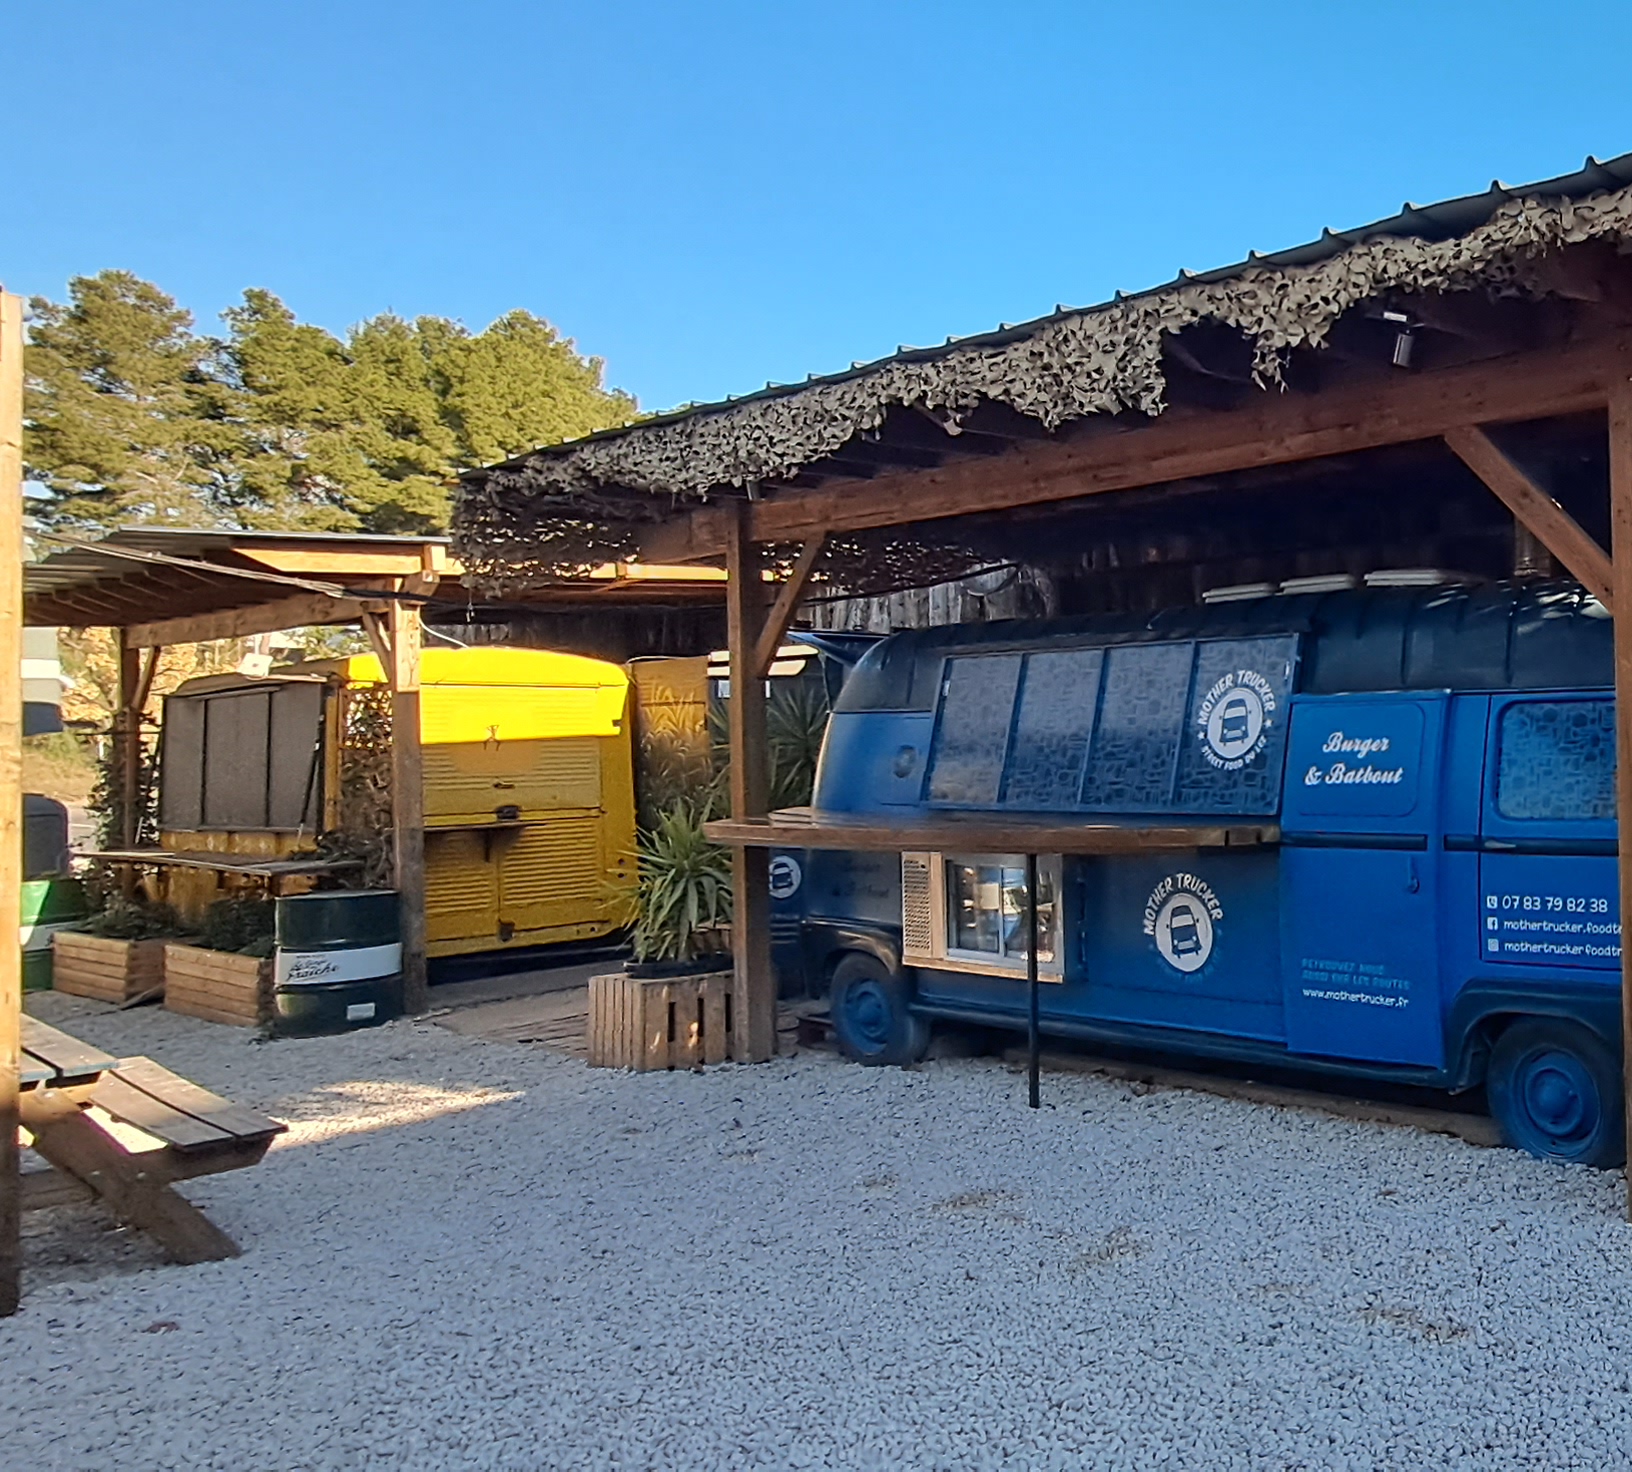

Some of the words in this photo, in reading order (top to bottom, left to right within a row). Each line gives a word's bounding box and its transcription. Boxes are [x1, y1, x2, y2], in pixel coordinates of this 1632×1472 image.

[1198, 673, 1234, 725] MOTHER
[1237, 670, 1275, 712] TRUCKER
[1322, 731, 1389, 759] Burger
[1304, 765, 1322, 785] &
[1325, 762, 1403, 785] Batbout
[1143, 877, 1173, 936] MOTHER
[1176, 873, 1223, 920] TRUCKER
[1502, 895, 1520, 909] 07
[1523, 896, 1541, 911] 83
[1545, 896, 1563, 911] 79
[1566, 897, 1585, 913] 82
[1589, 898, 1608, 913] 38
[1302, 988, 1409, 1008] www.mothertrucker.fr
